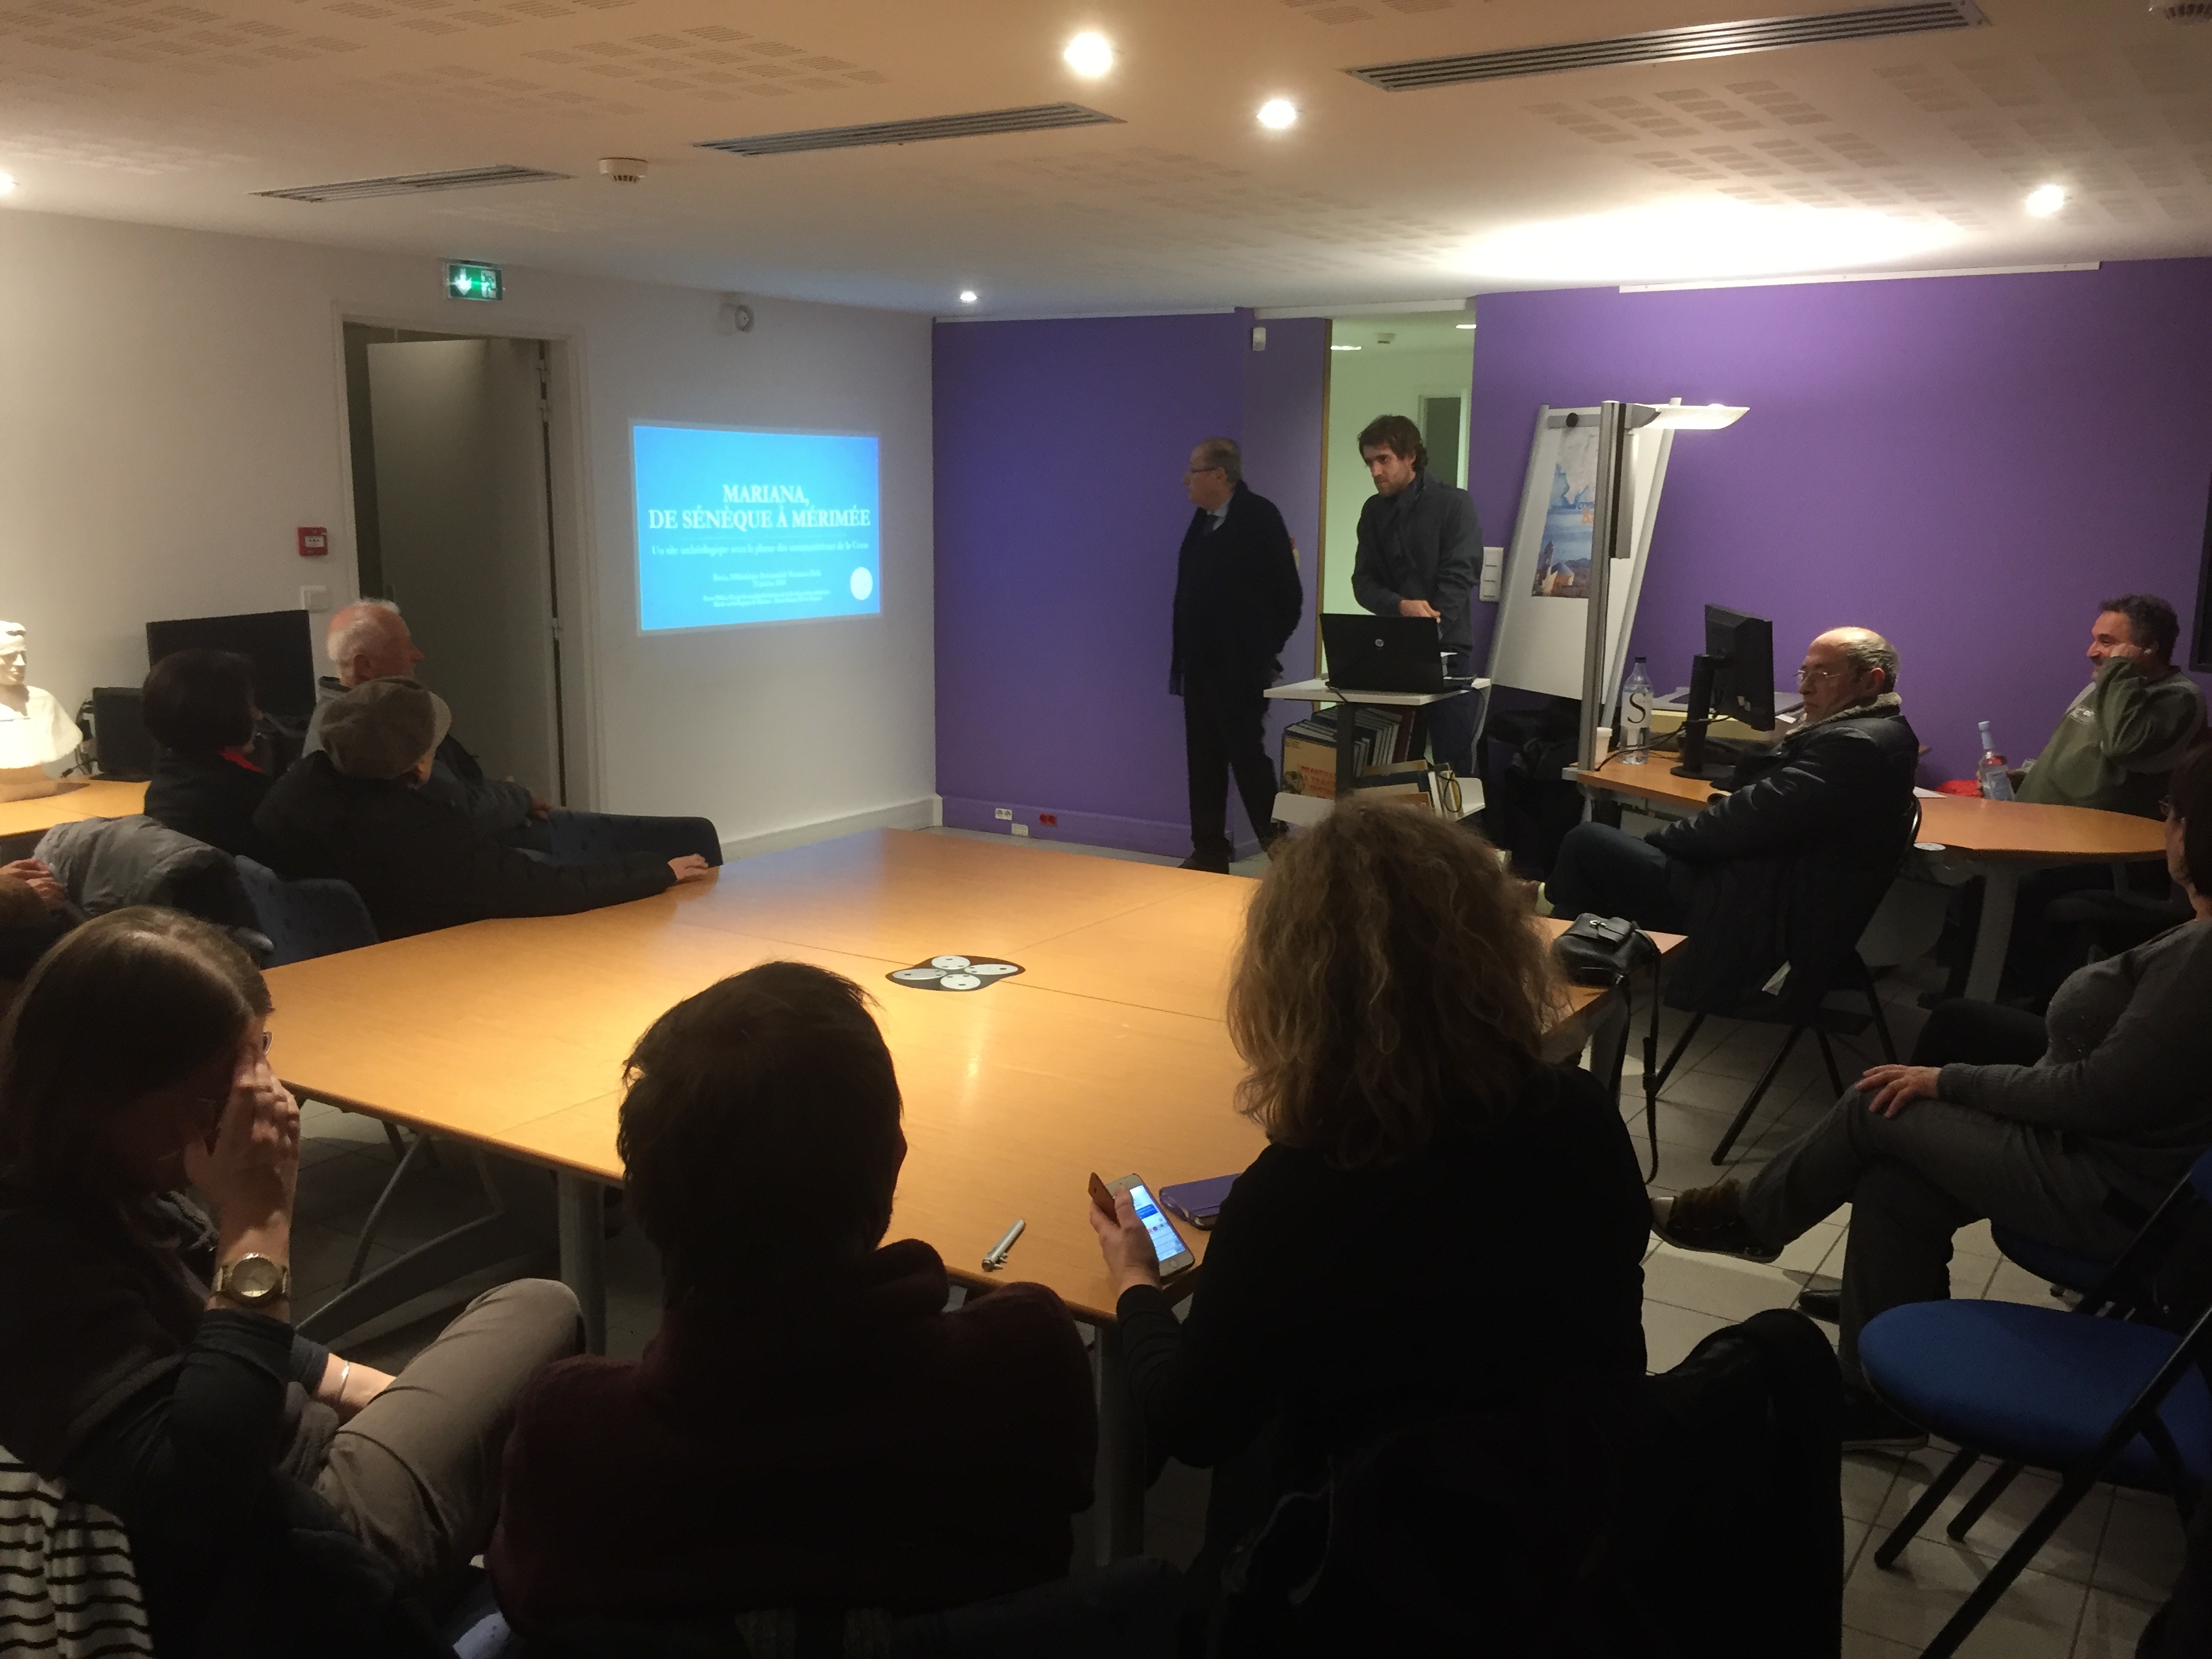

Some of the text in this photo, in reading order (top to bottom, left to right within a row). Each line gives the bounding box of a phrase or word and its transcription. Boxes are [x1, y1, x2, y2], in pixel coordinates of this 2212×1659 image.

[722, 483, 810, 507] MARIANA,
[648, 505, 872, 532] DE SÉNÈQUE À MÉRIMÉE
[652, 545, 664, 555] Un
[665, 544, 678, 554] site
[853, 540, 870, 550] Corse
[1627, 693, 1647, 724] S
